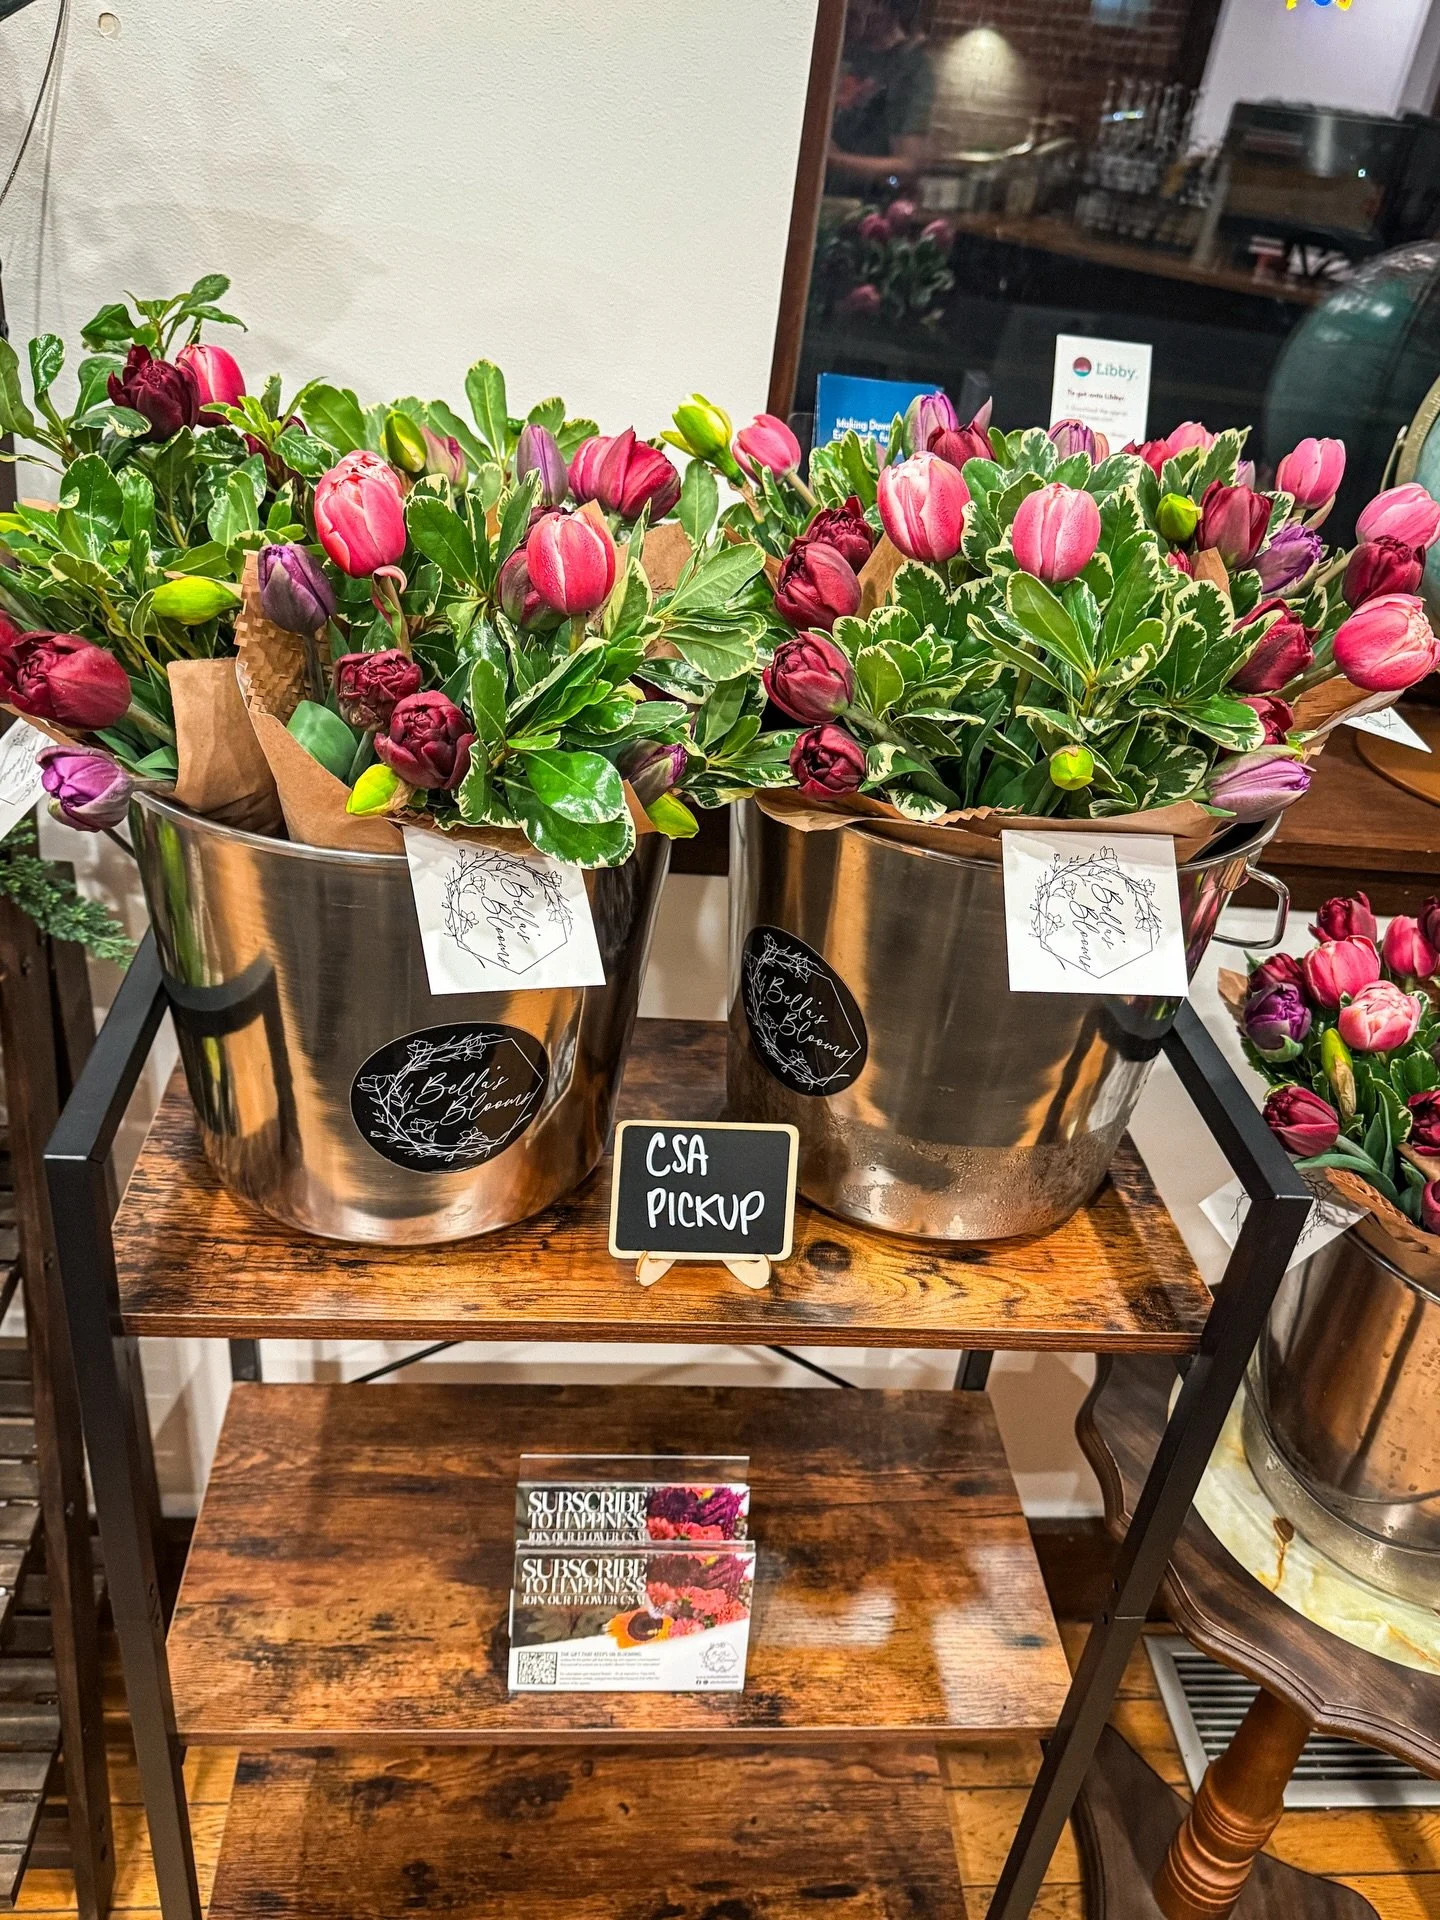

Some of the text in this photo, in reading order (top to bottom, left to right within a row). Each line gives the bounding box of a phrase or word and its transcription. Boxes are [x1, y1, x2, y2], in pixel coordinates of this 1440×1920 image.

[836, 416, 868, 433] Making
[499, 877, 542, 944] Bella's
[1091, 883, 1127, 950] Bella's
[480, 896, 516, 969] Blooms
[1069, 900, 1100, 972] Blooms
[765, 976, 829, 1025] Bella's
[779, 1012, 852, 1059] Blooms
[415, 1065, 510, 1105] Bella's
[439, 1091, 534, 1126] Blooms
[646, 1132, 709, 1177] CSA
[646, 1187, 765, 1236] PICKUP
[528, 1491, 648, 1514] SUBSCRIBE
[528, 1512, 647, 1529] TO HAPPINESS
[528, 1531, 549, 1543] JOIN
[552, 1531, 575, 1543] OUR
[577, 1531, 619, 1543] FLOWER
[522, 1558, 647, 1579] SUBSCRIBE
[522, 1577, 647, 1594] TO HAPPINESS
[522, 1595, 545, 1605] JOIN
[547, 1595, 571, 1605] OUR
[574, 1595, 618, 1605] FLOWER
